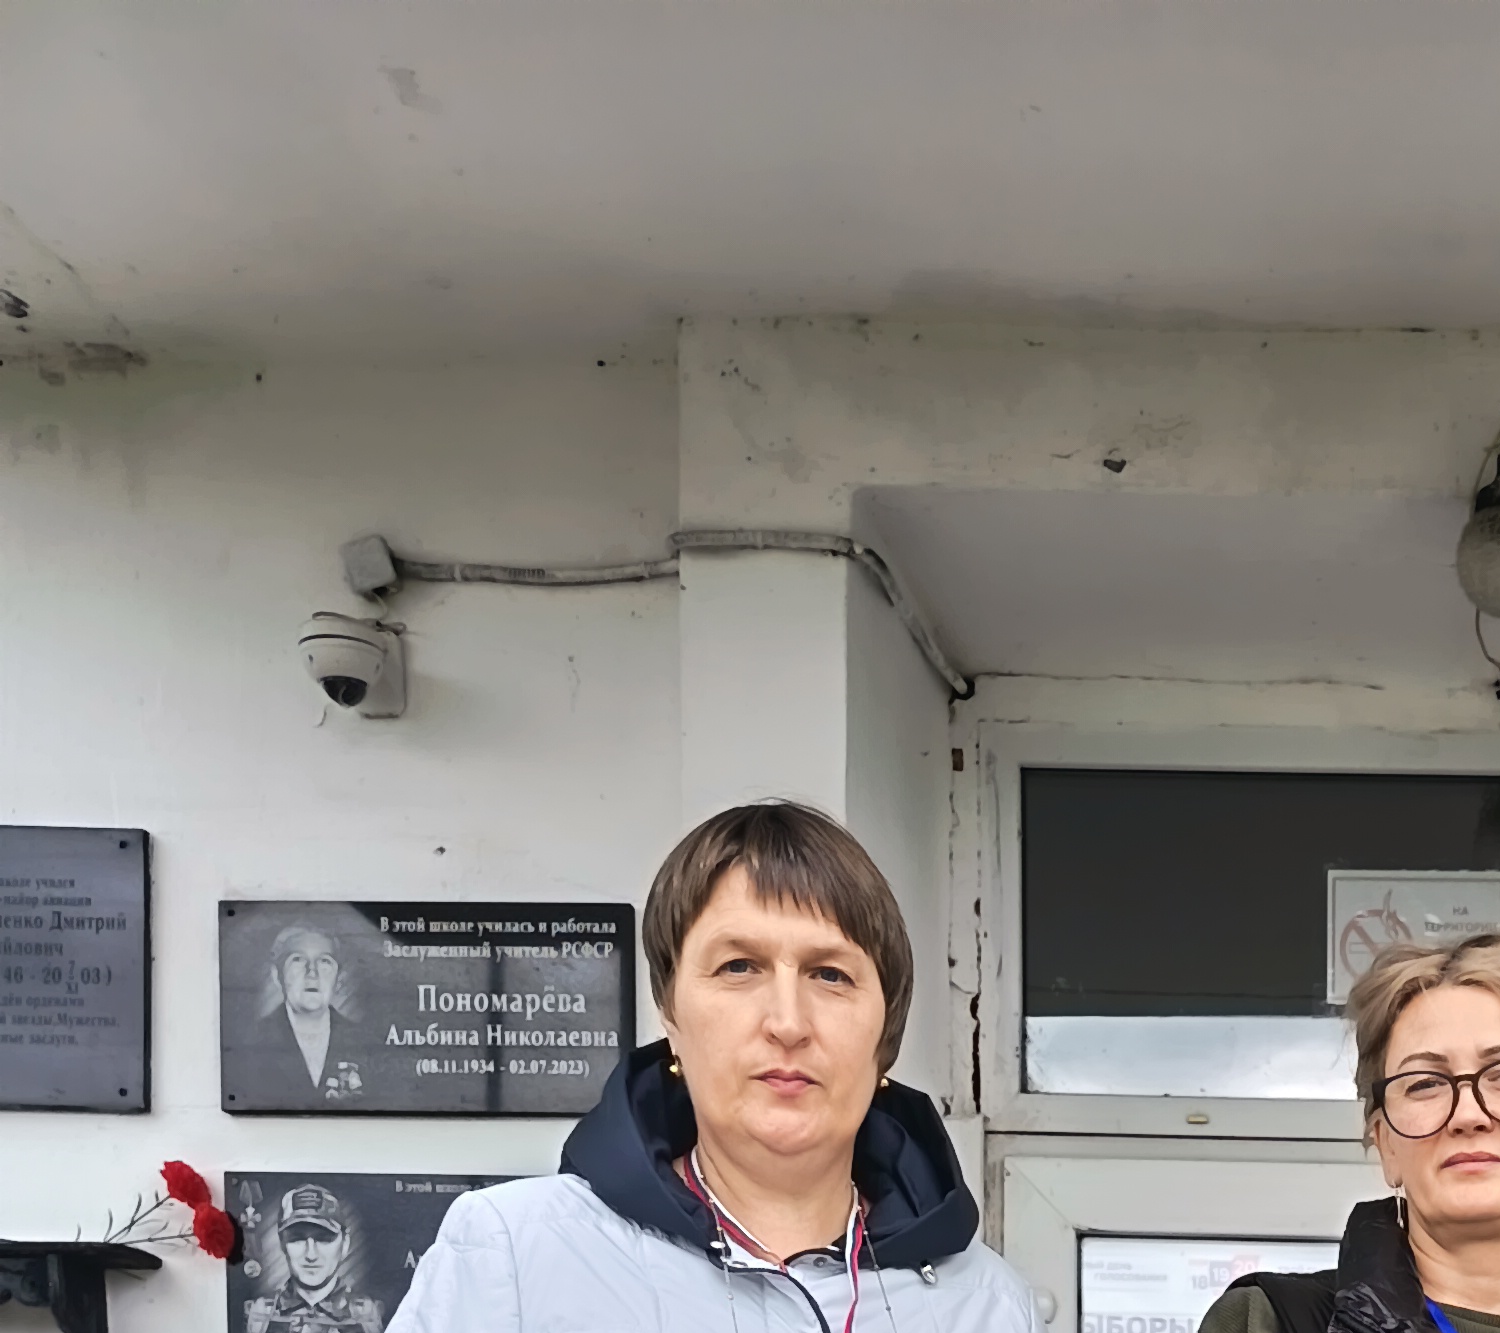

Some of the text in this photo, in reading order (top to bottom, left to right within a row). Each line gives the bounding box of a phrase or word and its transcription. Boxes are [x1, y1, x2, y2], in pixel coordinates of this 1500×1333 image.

[1452, 905, 1469, 917] НА
[49, 911, 127, 935] Дмитрий
[380, 917, 616, 937] В этой школе училась и работала
[383, 941, 614, 962] Заслуженный учитель РСФСР
[417, 984, 587, 1021] Пономарёва
[385, 1023, 619, 1047] Альбина Николаевна
[416, 1059, 495, 1077] (08.11.1934
[509, 1060, 590, 1078] 02.07.2023)
[396, 1180, 403, 1192] В
[1191, 1275, 1208, 1290] 18
[1213, 1268, 1229, 1283] 19
